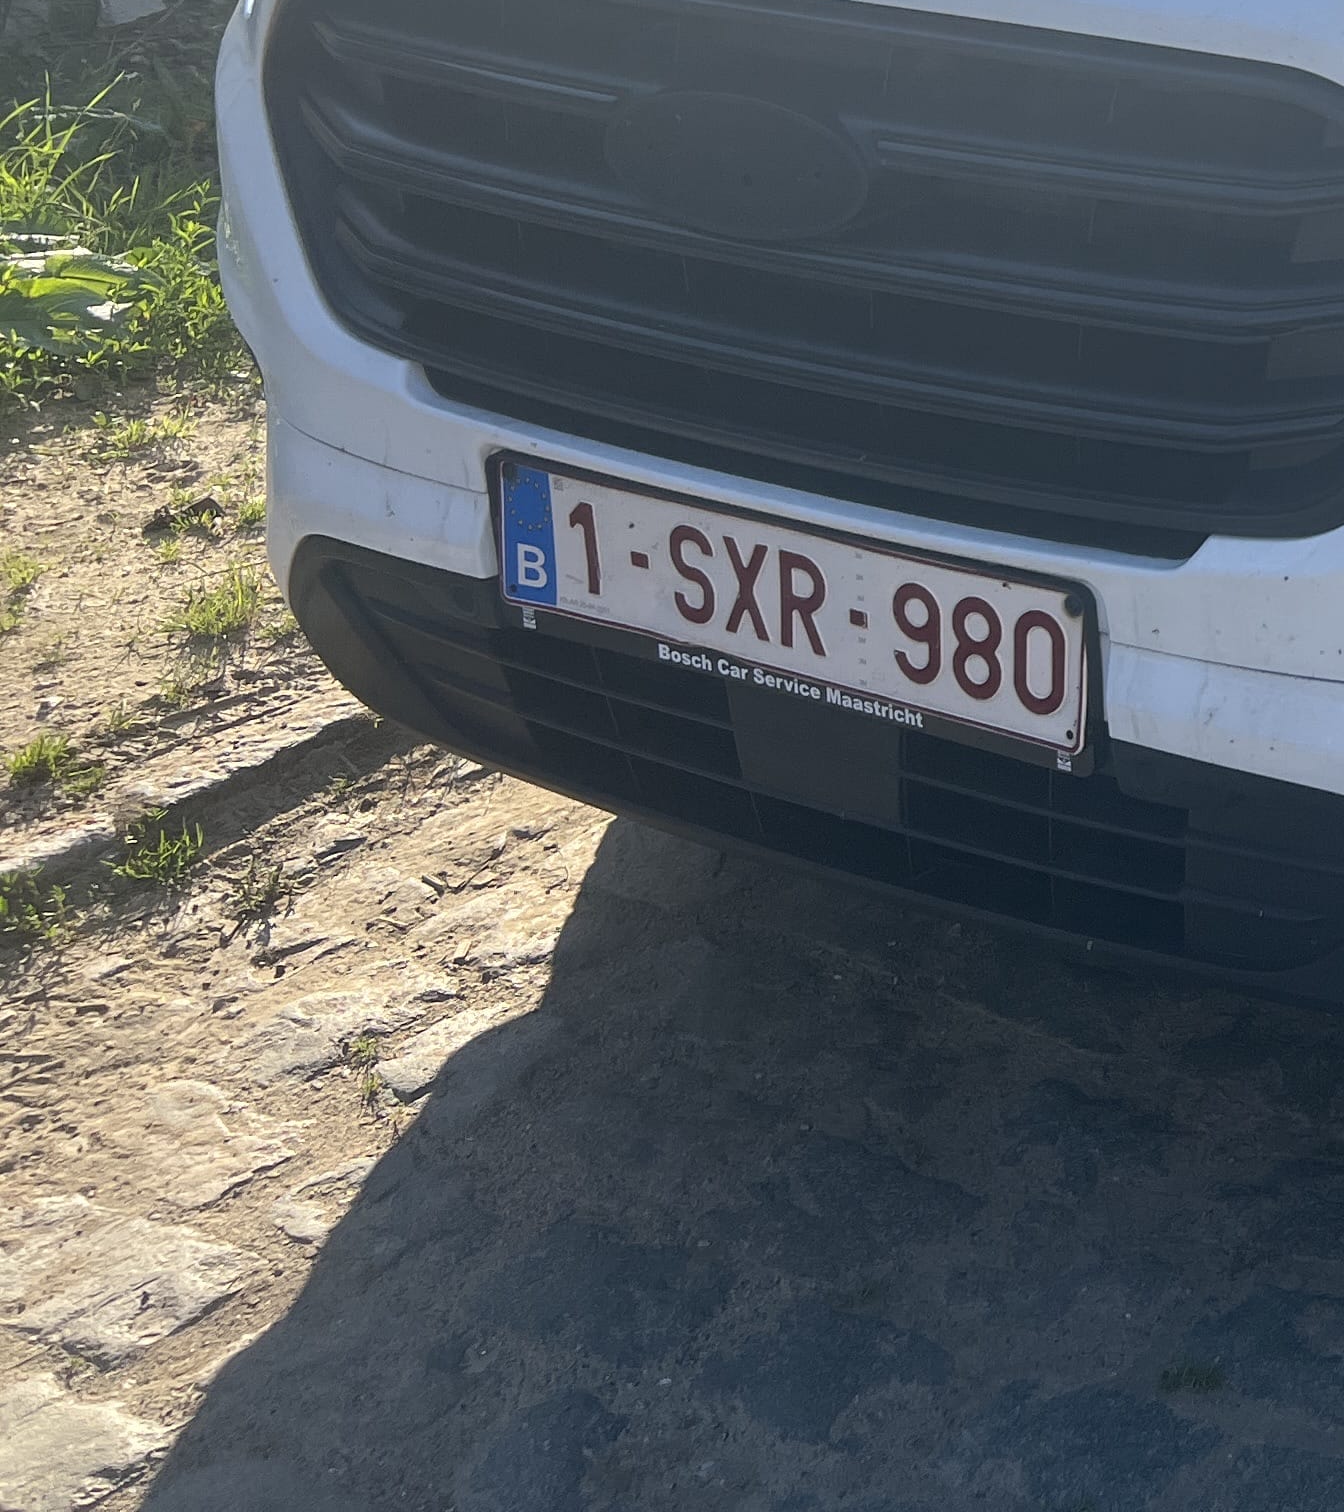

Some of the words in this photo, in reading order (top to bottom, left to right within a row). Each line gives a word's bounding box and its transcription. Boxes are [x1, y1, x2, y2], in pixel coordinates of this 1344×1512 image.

[517, 543, 547, 588] B
[658, 643, 713, 672] Bosch
[717, 658, 749, 681] Car
[753, 667, 821, 700] Service
[826, 686, 924, 729] Maastricht
